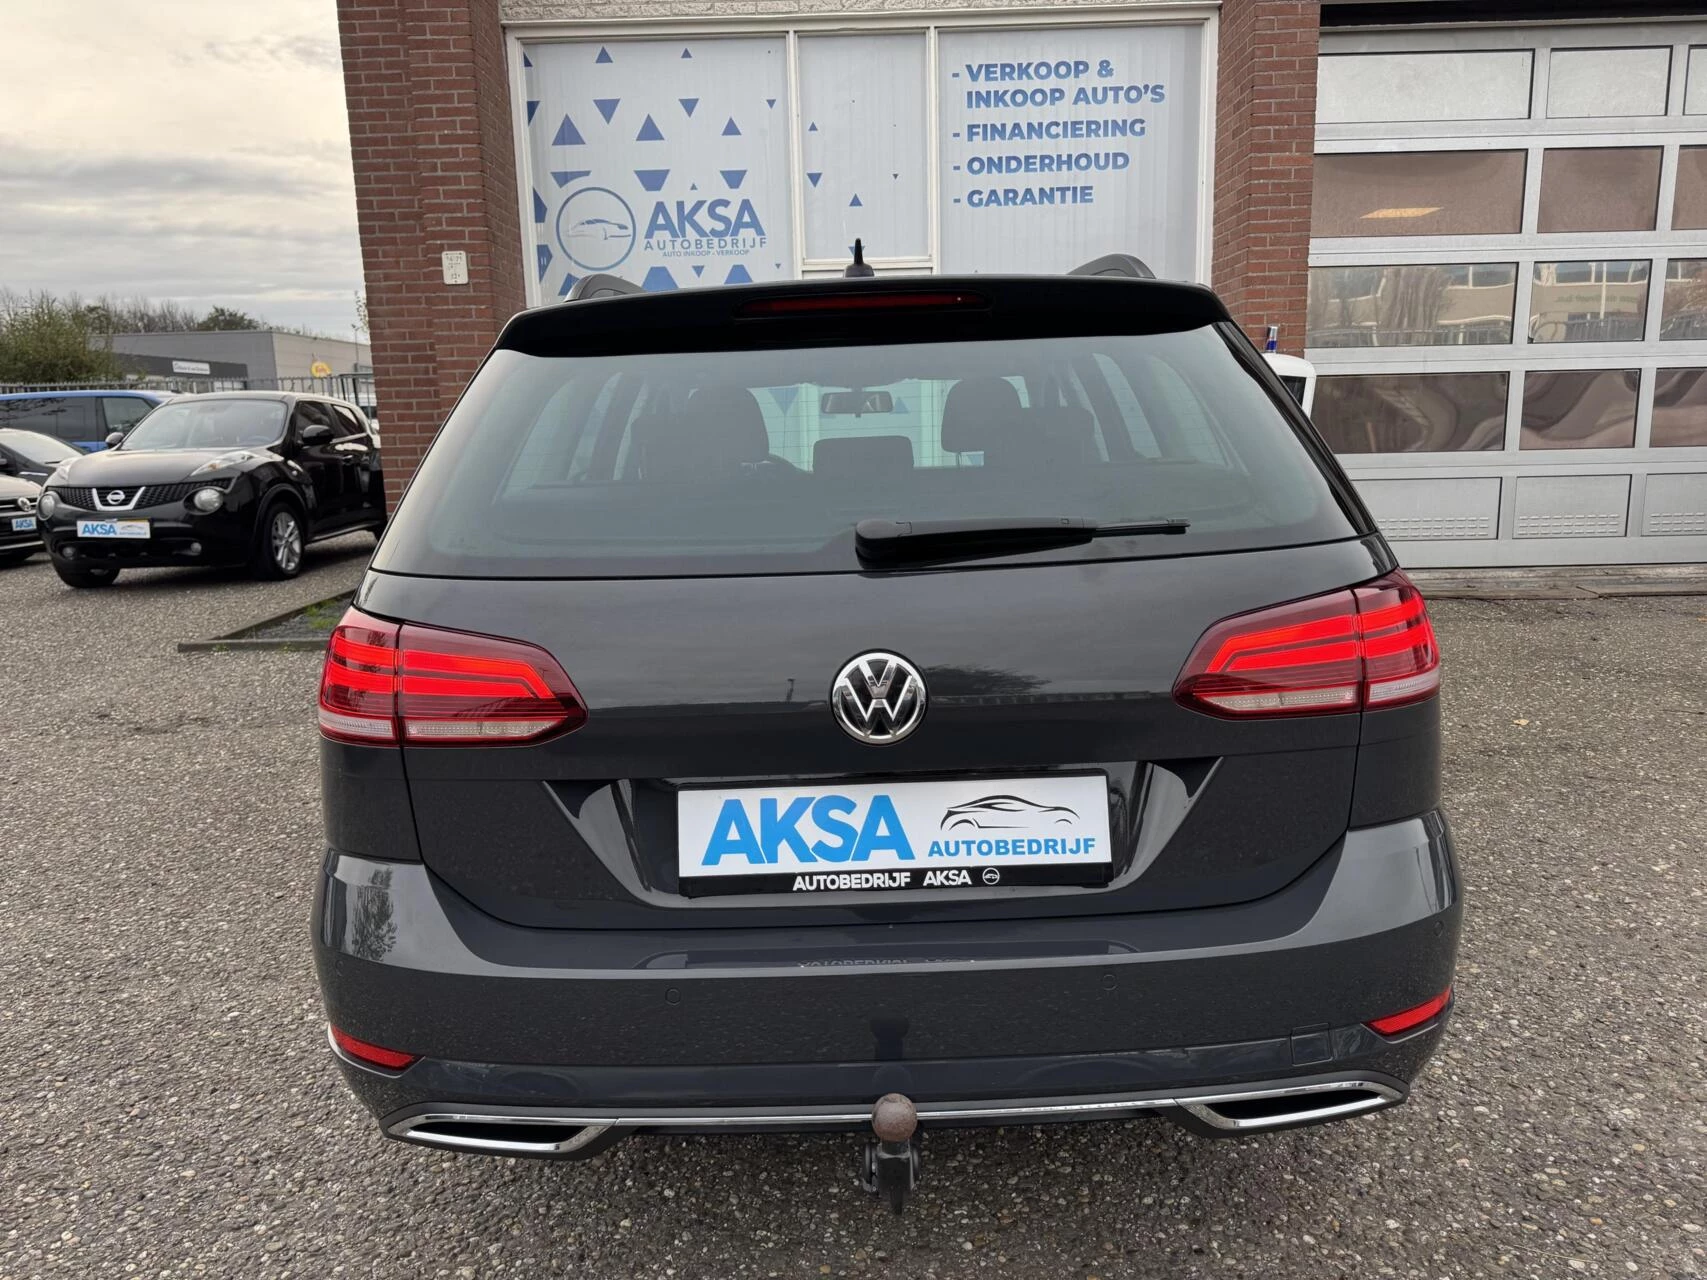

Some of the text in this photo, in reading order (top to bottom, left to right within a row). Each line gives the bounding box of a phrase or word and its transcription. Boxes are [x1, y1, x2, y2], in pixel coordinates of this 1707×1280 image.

[965, 60, 1090, 82] VERKOOP
[1097, 59, 1114, 78] &
[966, 84, 1165, 109] INKOOP AUTO'S
[967, 118, 1146, 142] FINANCIERING
[967, 152, 1130, 175] ONDERHOUD
[967, 186, 1094, 208] GARANTIE
[644, 198, 767, 239] AKSA
[644, 237, 768, 251] AUTOBEDRIJF
[82, 523, 117, 536] AKSA
[701, 794, 1096, 867] AKSA AUTOBEDRIJF
[792, 869, 972, 892] AUTOBEDRIJF AKSA
